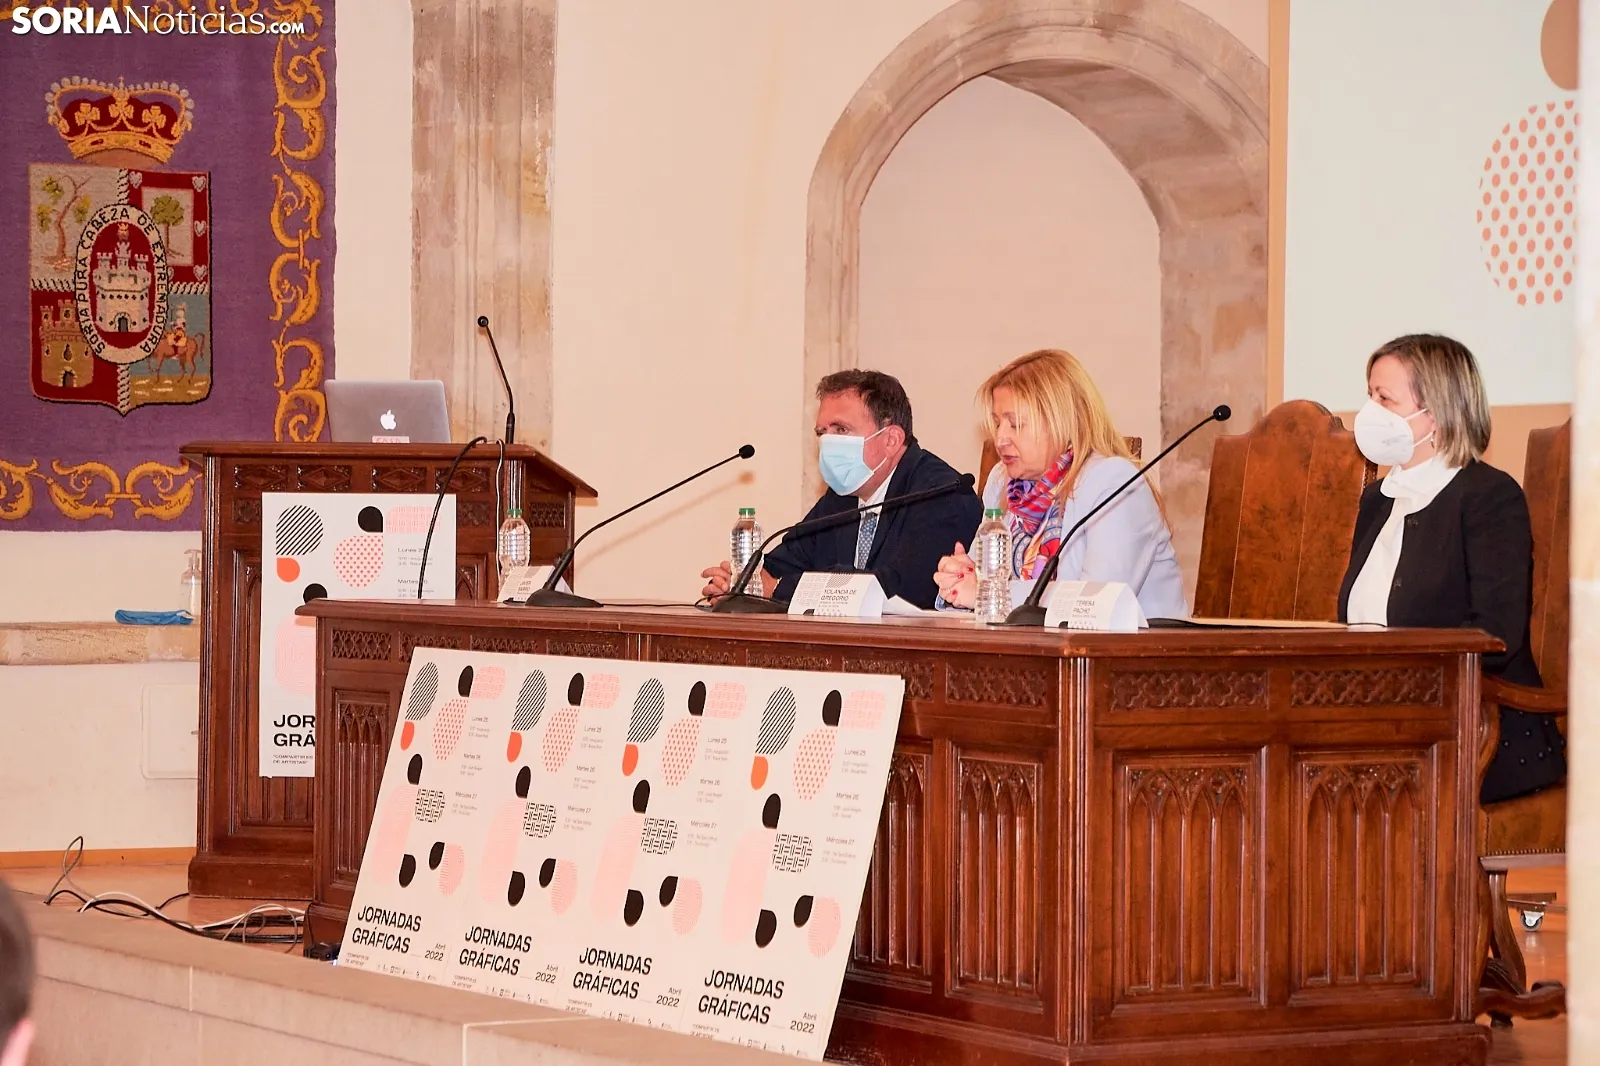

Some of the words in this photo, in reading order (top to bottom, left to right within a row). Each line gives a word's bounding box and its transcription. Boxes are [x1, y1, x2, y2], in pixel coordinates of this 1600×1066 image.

[80, 207, 130, 250] CABEZA
[137, 214, 154, 236] DE
[76, 256, 88, 303] PURA
[139, 240, 167, 354] EXTREMADURA
[79, 307, 105, 354] SORIA
[357, 906, 422, 932] JORNADAS
[352, 927, 411, 954] GRÁFICAS
[435, 943, 446, 951] Abril
[465, 926, 532, 953] JORNADAS
[424, 950, 444, 961] 2022
[459, 948, 520, 976] GRÁFICAS
[546, 964, 559, 972] Abril
[579, 947, 653, 975] JORNADAS
[535, 972, 557, 984] 2022
[573, 970, 640, 999] GRÁFICAS
[668, 987, 682, 996] Abril
[704, 969, 785, 999] JORNADAS
[656, 995, 680, 1008] 2022
[698, 994, 771, 1024] GRÁFICAS
[790, 1020, 815, 1034] 2022
[803, 1012, 817, 1021] Abril
